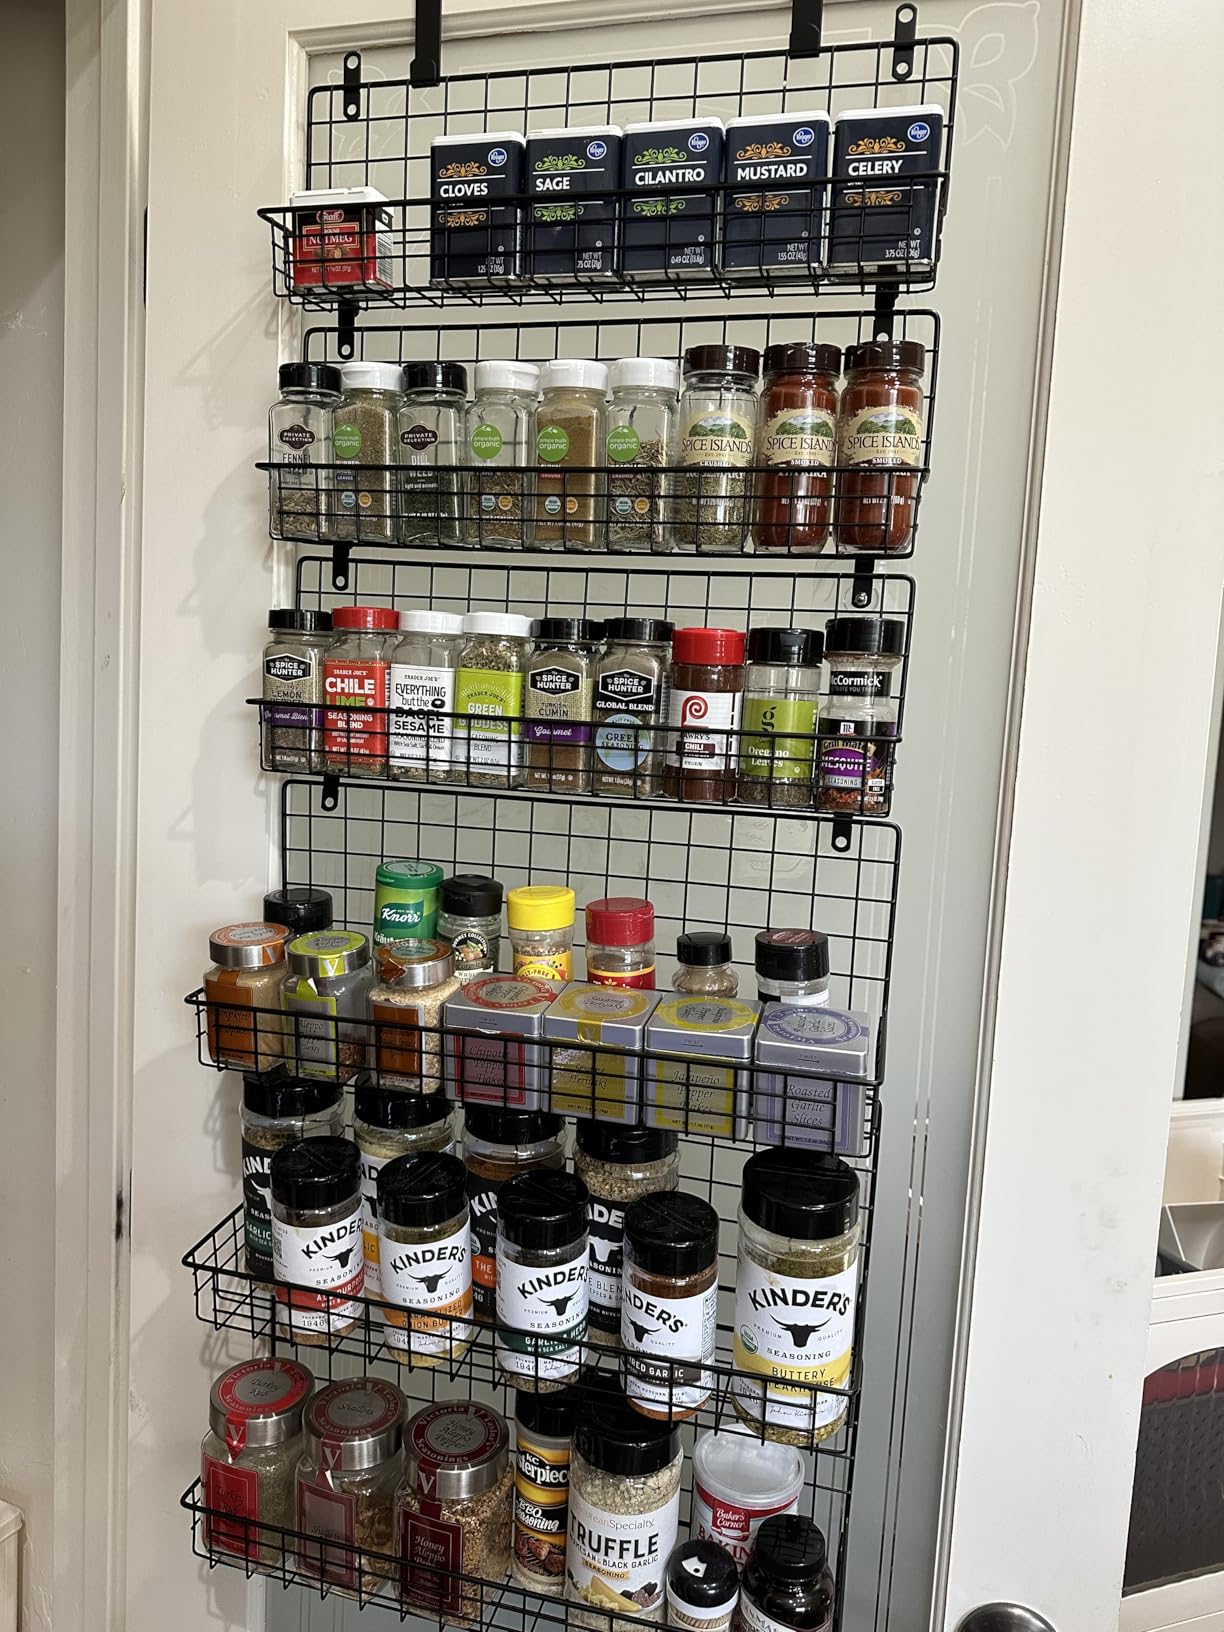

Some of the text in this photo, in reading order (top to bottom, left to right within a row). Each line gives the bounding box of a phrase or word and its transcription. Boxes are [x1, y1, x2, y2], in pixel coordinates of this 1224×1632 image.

[737, 164, 807, 181] MUSTARD
[848, 160, 903, 176] CELERY
[635, 168, 705, 185] CILANTRO
[440, 183, 488, 197] CLOVES
[535, 177, 570, 191] SAGE
[684, 247, 694, 255] NET
[798, 243, 808, 251] WT
[787, 252, 795, 260] OZ
[473, 440, 500, 448] organic
[540, 442, 567, 450] organic
[609, 442, 637, 450] organic
[682, 438, 752, 455] SPICE ISLANDS
[767, 435, 797, 451] SPICE
[848, 435, 920, 451] SPICE ISLANDS
[790, 458, 819, 466] SMOKED
[270, 668, 303, 676] HUNTER
[275, 661, 298, 669] SPICE
[325, 677, 375, 694] CHILE
[537, 682, 572, 690] HUNTER
[542, 675, 567, 683] SPICE
[613, 677, 639, 686] SPICE
[831, 674, 880, 688] cCormick
[271, 691, 302, 699] LEMON
[395, 683, 446, 698] EVERYTHING
[466, 690, 488, 699] TRADER
[607, 684, 644, 693] HUNTER
[401, 696, 429, 707] but the
[596, 700, 655, 711] GLOBAL BLEND
[467, 702, 503, 716] GREEN
[538, 708, 569, 717] CUMIN
[394, 720, 444, 734] SESAME
[473, 743, 492, 752] BLEND
[684, 742, 704, 750] CHILI
[748, 745, 789, 757] Oregno
[821, 755, 871, 771] MESQUITE
[828, 777, 858, 786] SEASONING
[382, 907, 421, 923] Knorr
[583, 999, 625, 1010] Teriyaki
[673, 1070, 720, 1087] Jaapeño
[677, 1085, 714, 1101] Ppper
[786, 1084, 833, 1098] Roasted
[791, 1100, 825, 1112] Garlic
[793, 1112, 823, 1126] Slices
[390, 1245, 466, 1275] KINDER'S
[475, 1260, 492, 1273] THE
[589, 1287, 607, 1299] EPPER
[596, 1280, 623, 1294] BLEN
[402, 1287, 461, 1305] SEASONING
[748, 1286, 850, 1316] KINDER'S
[623, 1288, 684, 1334] NDER'S
[303, 1319, 325, 1327] 1946
[753, 1323, 783, 1340] PREMIUM
[817, 1328, 843, 1342] QUALITY
[650, 1339, 676, 1347] QUALITY
[766, 1346, 831, 1361] SEASONING
[649, 1366, 684, 1378] GARIC
[771, 1366, 826, 1381] BUTTERY
[250, 1378, 281, 1391] Turkey
[336, 1402, 375, 1416] Shallots
[228, 1424, 245, 1445] V
[419, 1406, 498, 1450] Victoria Taylor's
[440, 1426, 472, 1442] Aleppo
[446, 1419, 477, 1437] Honey
[433, 1433, 466, 1449] Pepper
[323, 1446, 341, 1468] V
[416, 1437, 469, 1463] Seasonings
[526, 1453, 540, 1465] KC
[418, 1471, 435, 1494] V
[716, 1506, 745, 1522] Baker's
[716, 1517, 746, 1528] Corner
[569, 1509, 660, 1560] TRUFFLE
[414, 1535, 445, 1554] Honey
[413, 1545, 446, 1564] Aleppo
[602, 1554, 659, 1569] BLACK GARLIC
[584, 1559, 626, 1580] SEASONING
